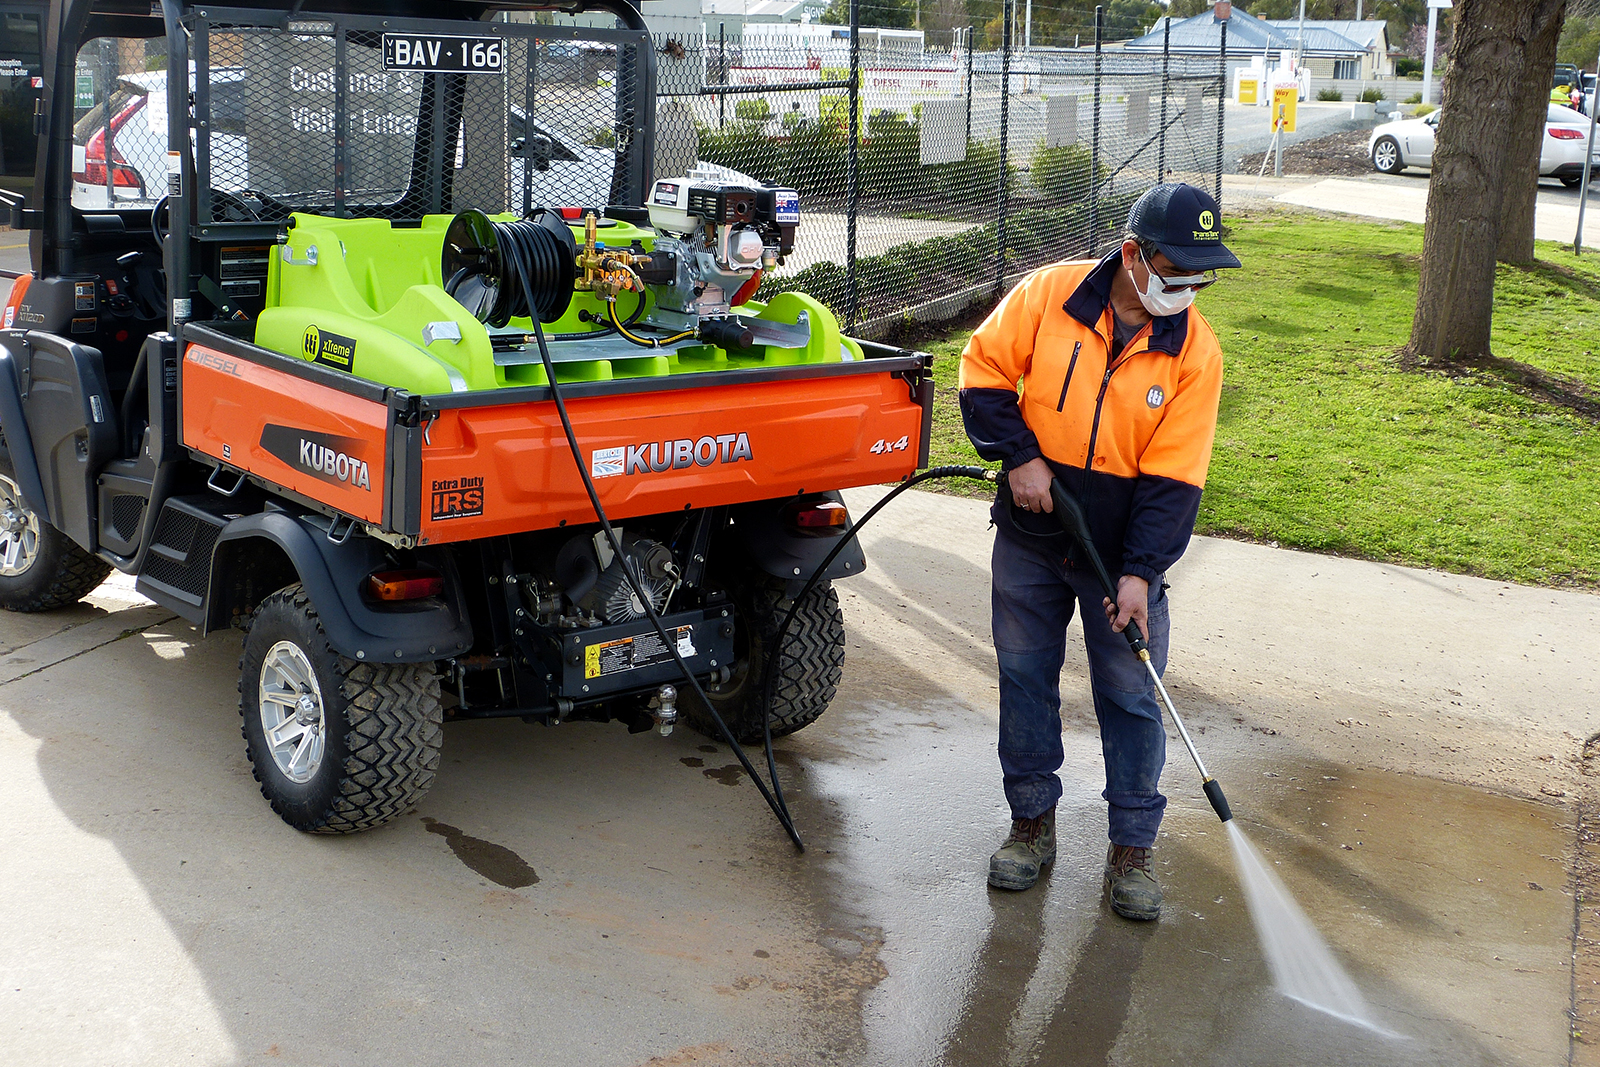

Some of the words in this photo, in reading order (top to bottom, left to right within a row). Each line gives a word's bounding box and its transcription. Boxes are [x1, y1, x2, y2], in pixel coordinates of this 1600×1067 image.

[804, 5, 825, 18] SIGNS
[386, 39, 394, 65] VIC
[395, 39, 442, 67] BAV
[461, 41, 501, 68] 166
[0, 59, 22, 67] eception
[15, 68, 29, 76] Enter
[290, 65, 388, 93] Custmer
[740, 76, 768, 85] WATER
[873, 78, 902, 89] DIESEL
[921, 79, 940, 89] FIRE
[1275, 89, 1290, 98] Way
[187, 349, 242, 377] DIESEL
[626, 431, 754, 476] KUBOTA
[869, 435, 909, 455] 4x4
[299, 438, 372, 492] KUBOTA
[432, 479, 459, 491] Extra
[460, 476, 484, 488] Duty
[433, 490, 482, 514] IRS
